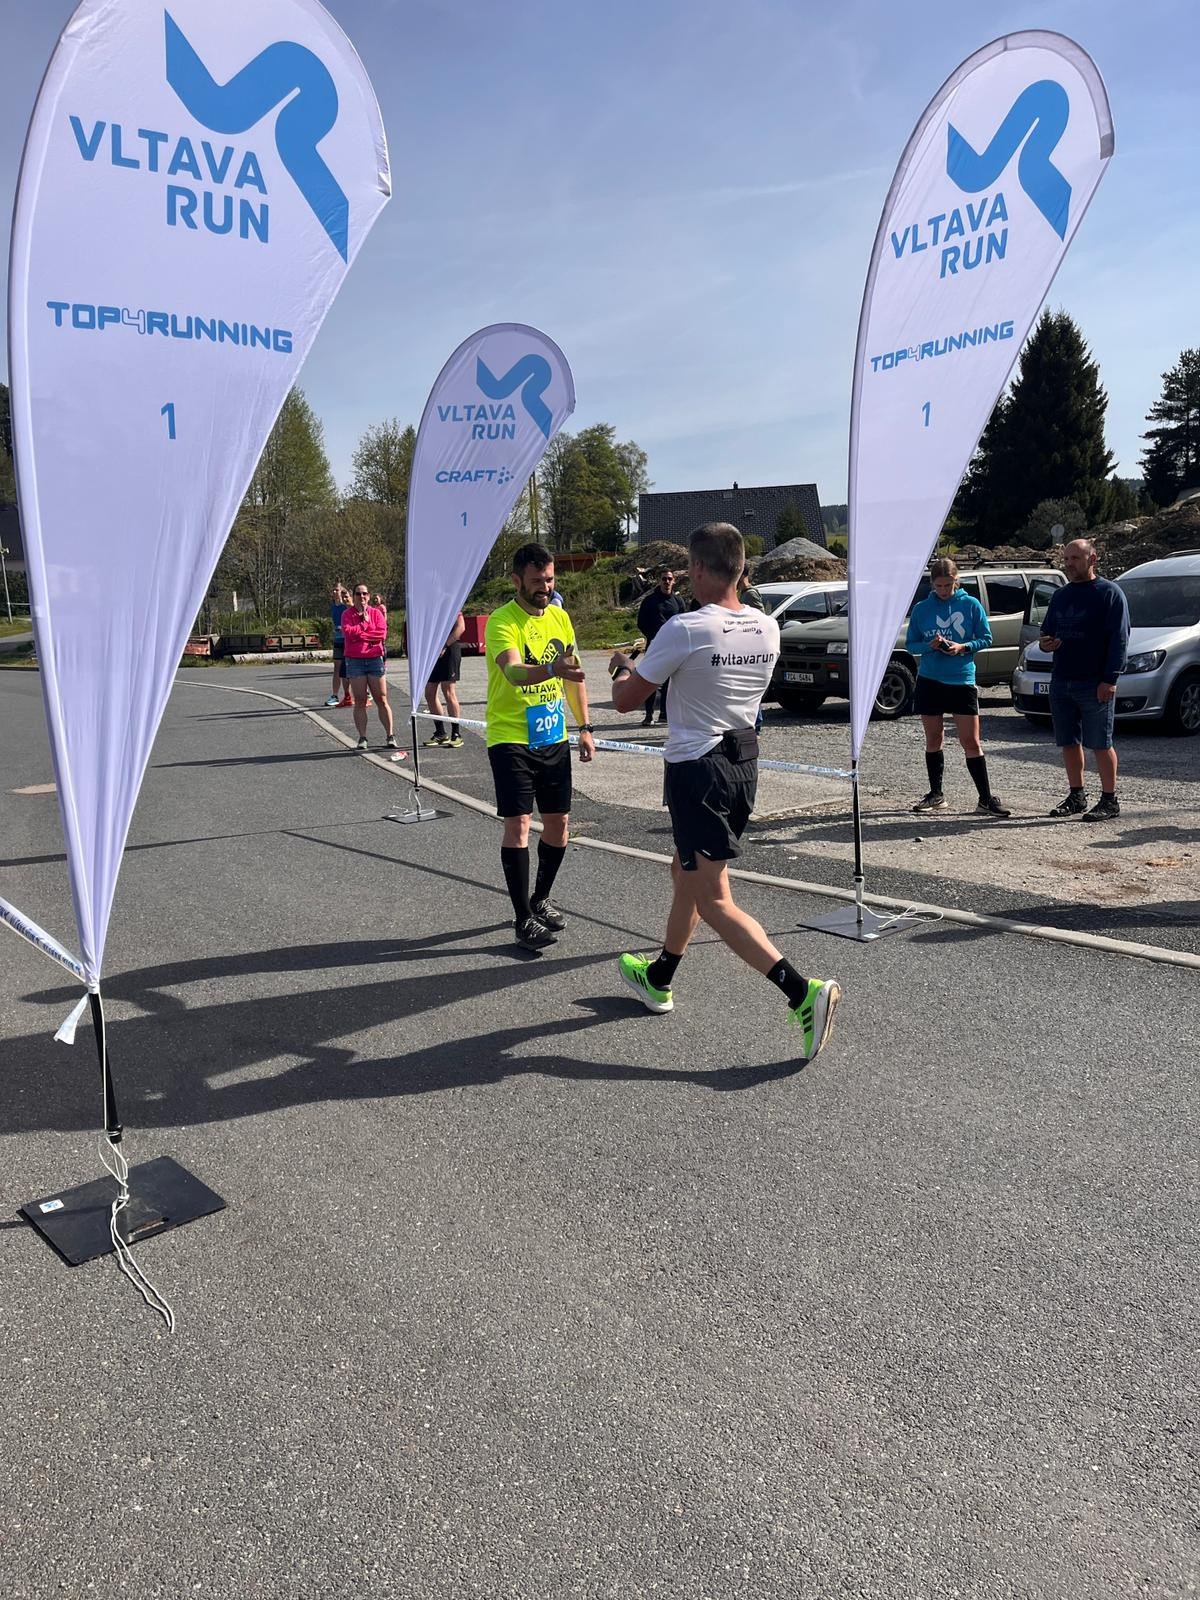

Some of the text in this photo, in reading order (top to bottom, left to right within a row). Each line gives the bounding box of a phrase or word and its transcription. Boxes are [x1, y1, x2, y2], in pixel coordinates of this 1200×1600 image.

[69, 115, 268, 195] VLTAVA
[166, 184, 269, 244] RUN
[891, 192, 1009, 259] VLTAVA
[939, 228, 1009, 278] RUN
[47, 300, 293, 354] TOP4RUNNING
[870, 320, 1015, 373] TOP4RUNNING
[160, 402, 177, 440] 1
[437, 404, 516, 422] VLTAVA
[921, 401, 932, 427] 1
[471, 423, 516, 440] RUN
[435, 469, 498, 484] CRAFT
[460, 511, 468, 527] 1
[711, 652, 775, 667] #vltavarun
[521, 684, 557, 694] VLTAVA
[535, 713, 559, 733] 209
